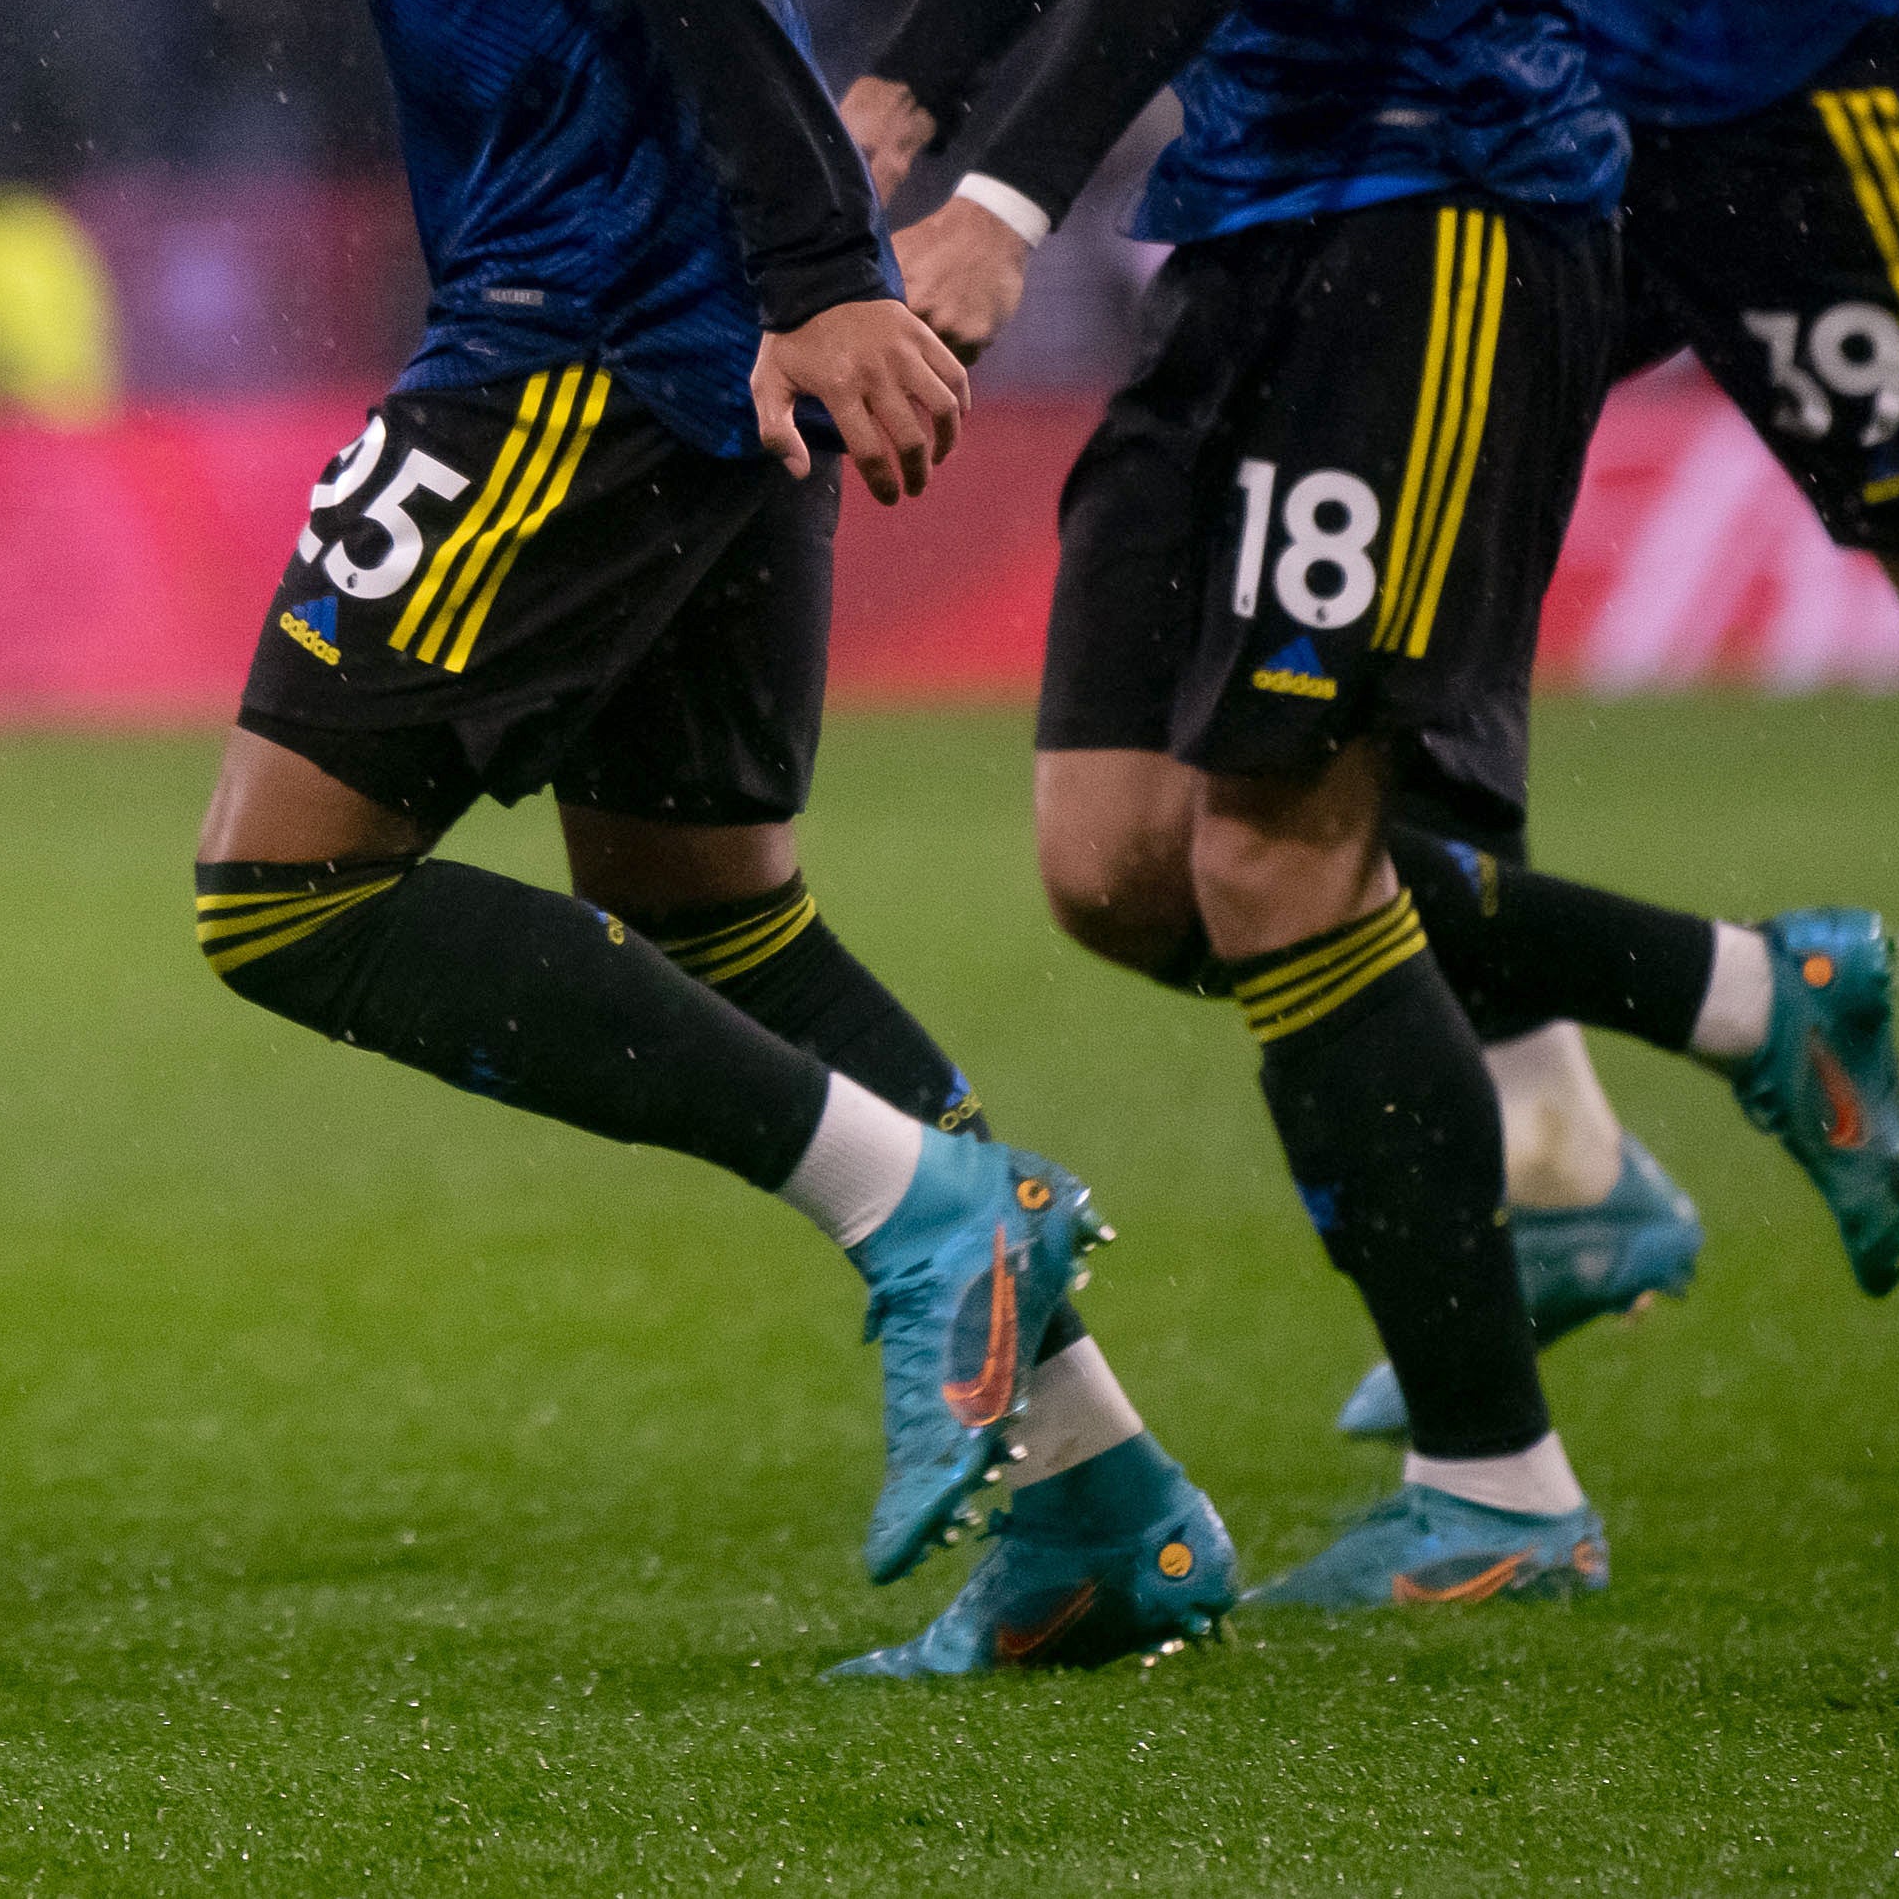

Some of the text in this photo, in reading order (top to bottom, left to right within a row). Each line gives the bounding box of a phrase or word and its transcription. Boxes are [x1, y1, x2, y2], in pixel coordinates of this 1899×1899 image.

[299, 415, 471, 600] 25
[1232, 459, 1381, 629] 18
[280, 612, 341, 666] adidas
